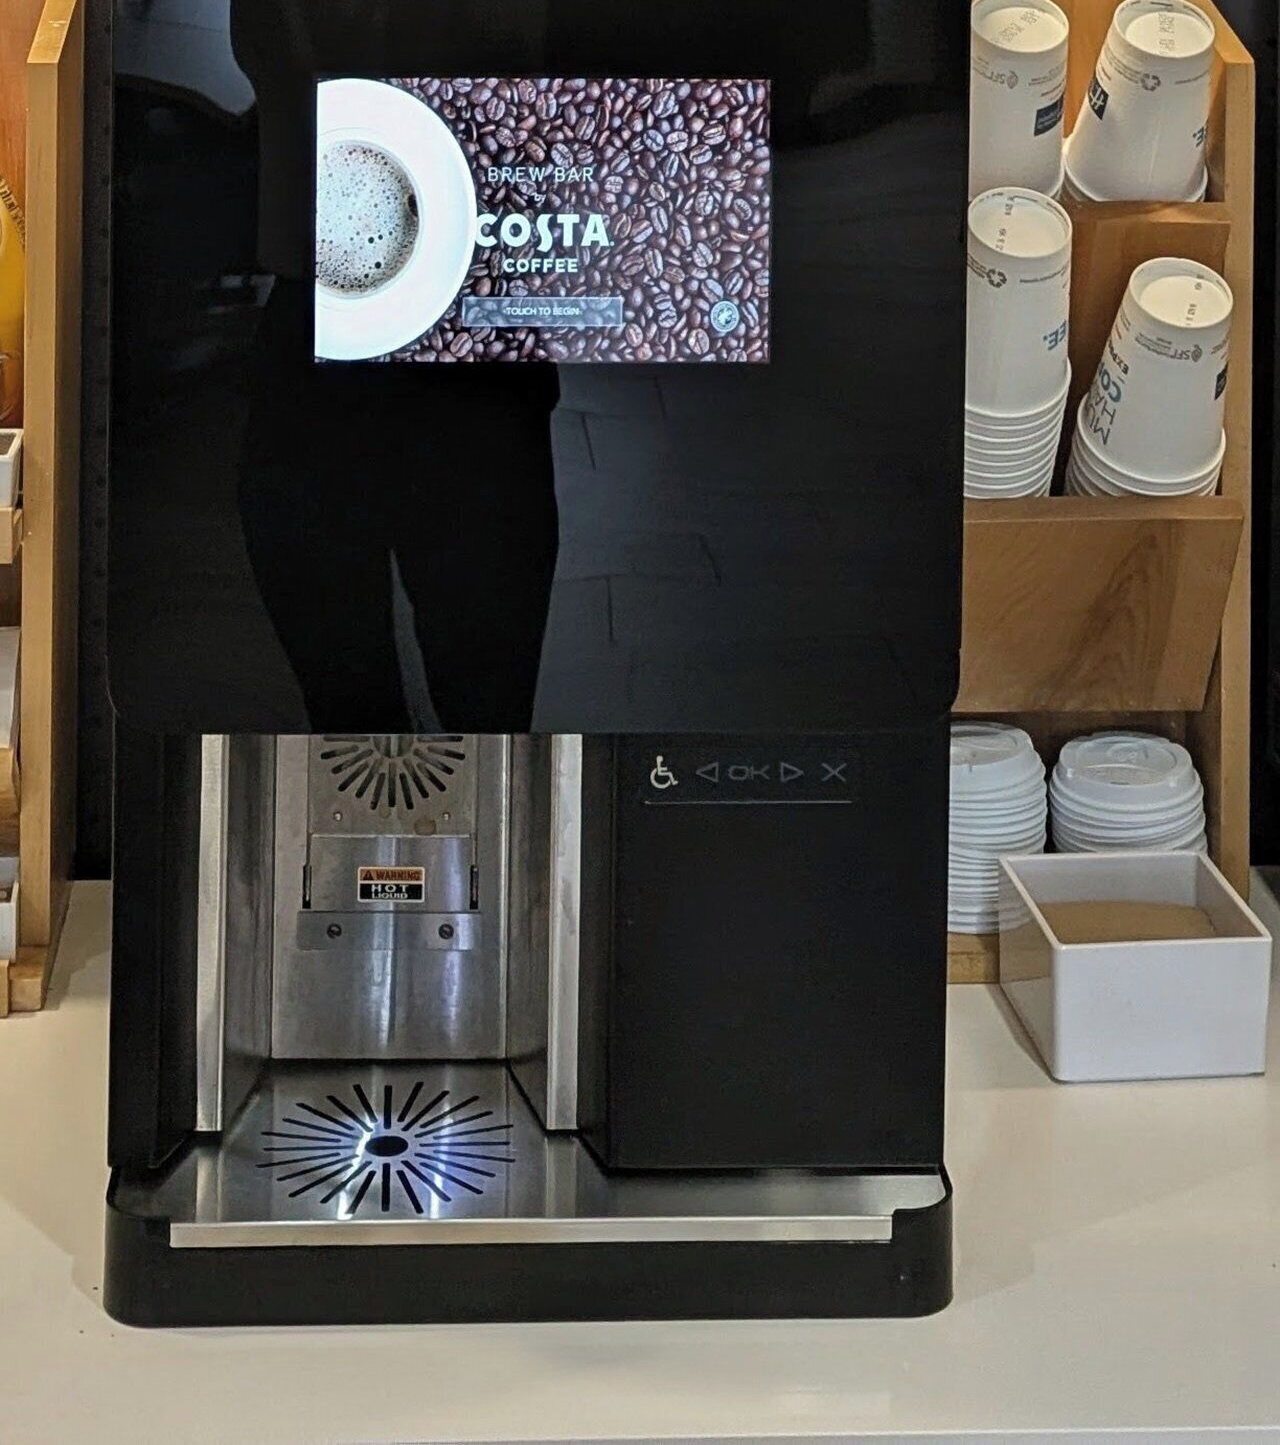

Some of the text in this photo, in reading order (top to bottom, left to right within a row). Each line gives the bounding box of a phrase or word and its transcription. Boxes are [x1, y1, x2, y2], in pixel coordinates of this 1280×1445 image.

[488, 166, 594, 182] BREW BAR
[475, 212, 611, 253] COSTA
[502, 257, 579, 273] COFFEE
[538, 306, 551, 316] TO
[727, 764, 770, 781] OK
[375, 870, 421, 881] WARNING
[371, 884, 409, 893] HOT
